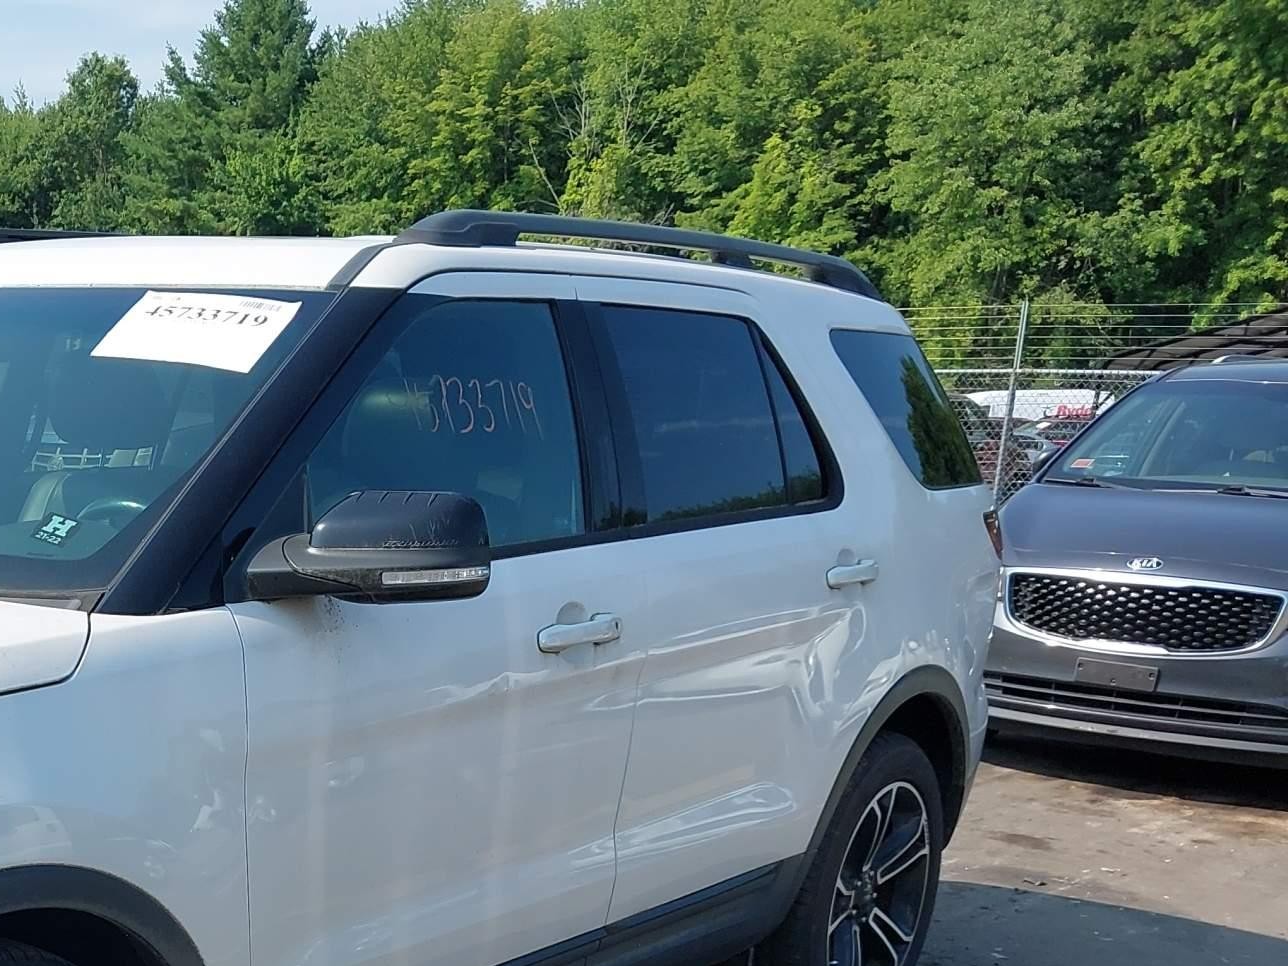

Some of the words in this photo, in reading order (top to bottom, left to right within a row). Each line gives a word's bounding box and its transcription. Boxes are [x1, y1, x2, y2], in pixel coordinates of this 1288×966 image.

[145, 305, 269, 327] 45733719
[41, 515, 78, 537] H
[1132, 557, 1158, 570] KIA
